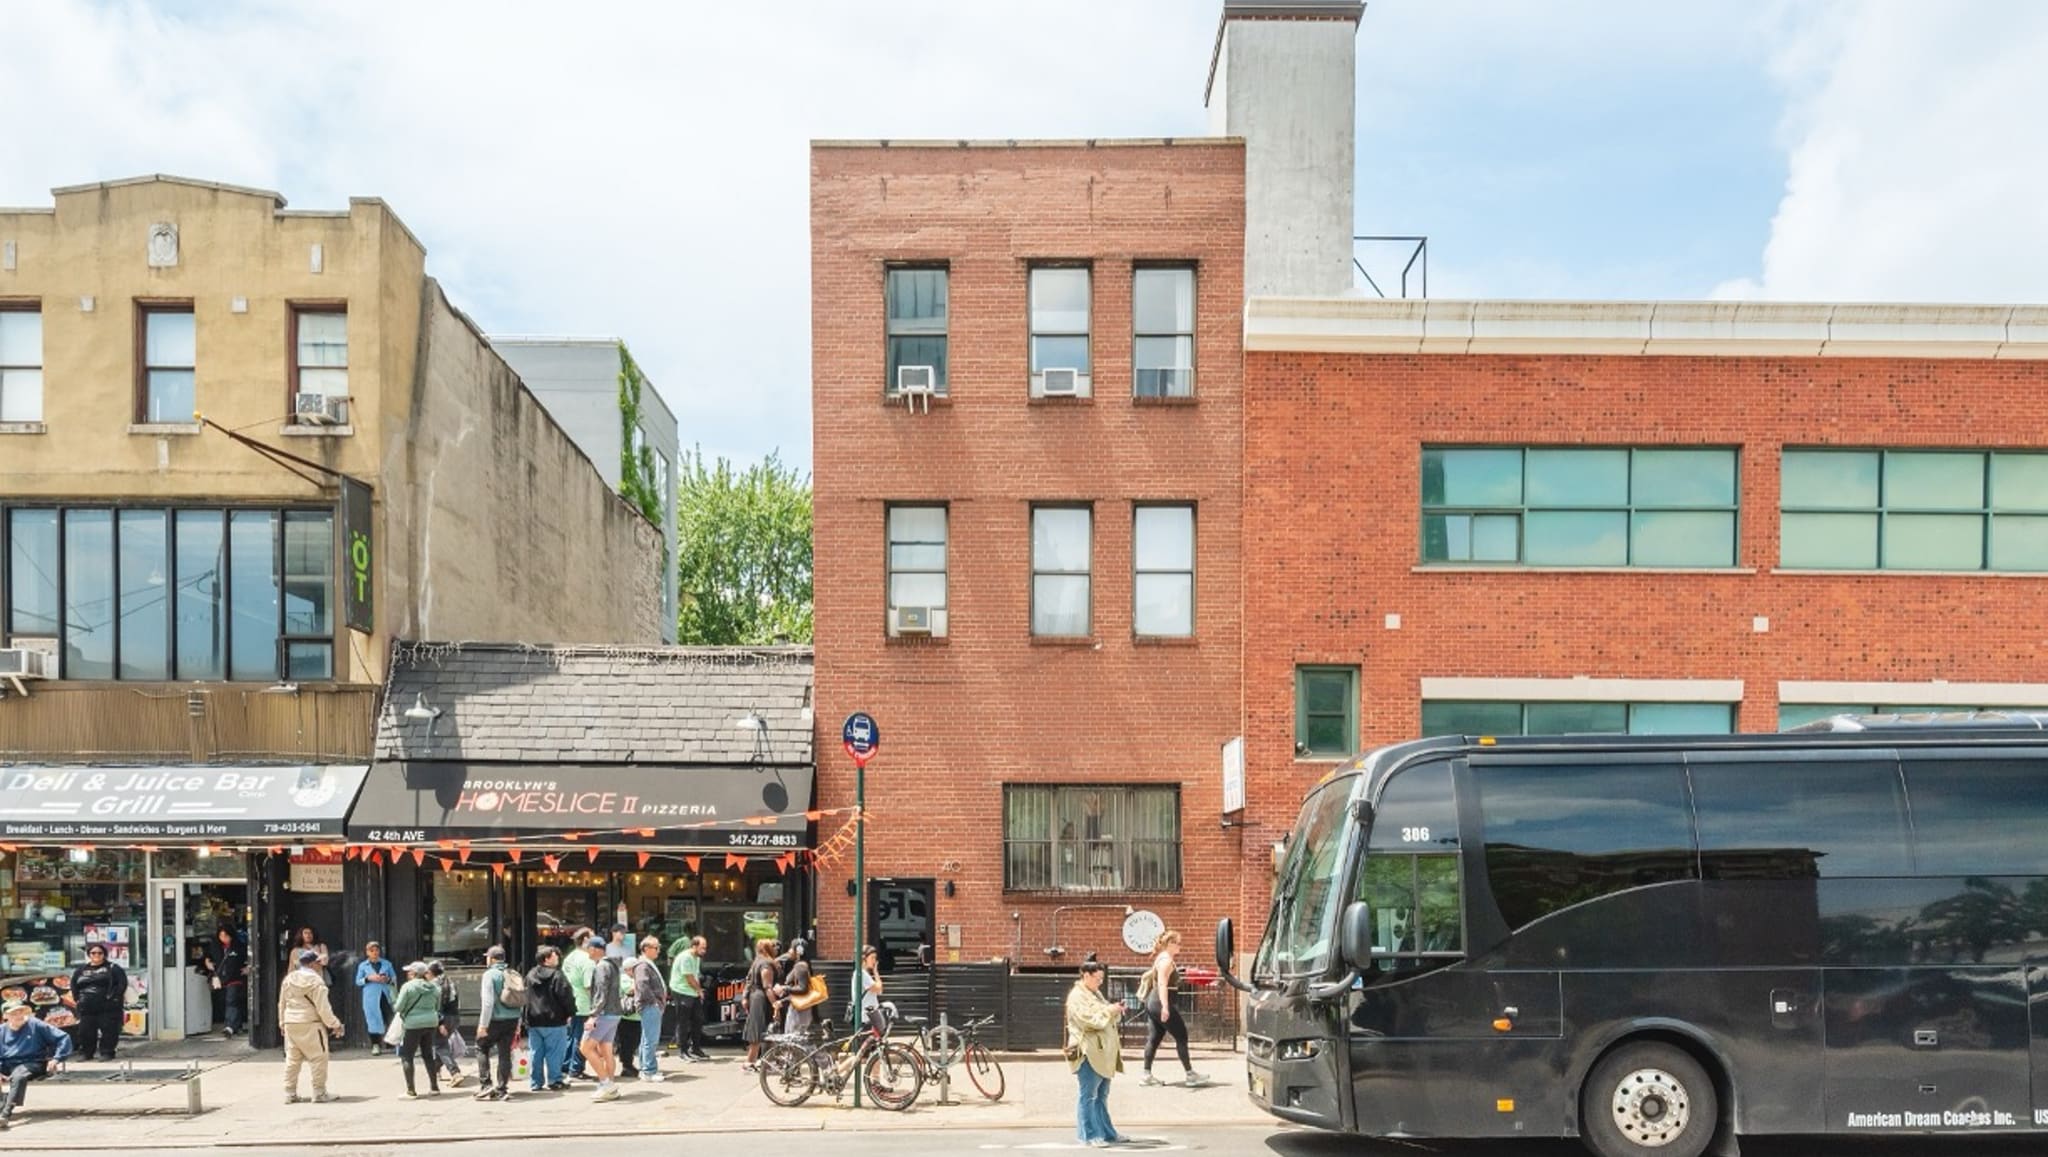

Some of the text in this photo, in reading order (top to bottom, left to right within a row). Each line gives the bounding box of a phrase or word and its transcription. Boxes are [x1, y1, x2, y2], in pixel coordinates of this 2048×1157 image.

[6, 772, 276, 791] Deli & Juice Bar
[463, 780, 557, 790] BROOKLYN'S
[91, 795, 166, 814] Grill
[454, 790, 617, 813] HOMESLICE
[641, 803, 717, 816] PIZZERIA
[368, 831, 425, 841] 42 4th AVE
[729, 834, 797, 845] 347-227-8833
[1402, 826, 1430, 842] 306
[1847, 1109, 2016, 1128] American Dream Coaches Inc.
